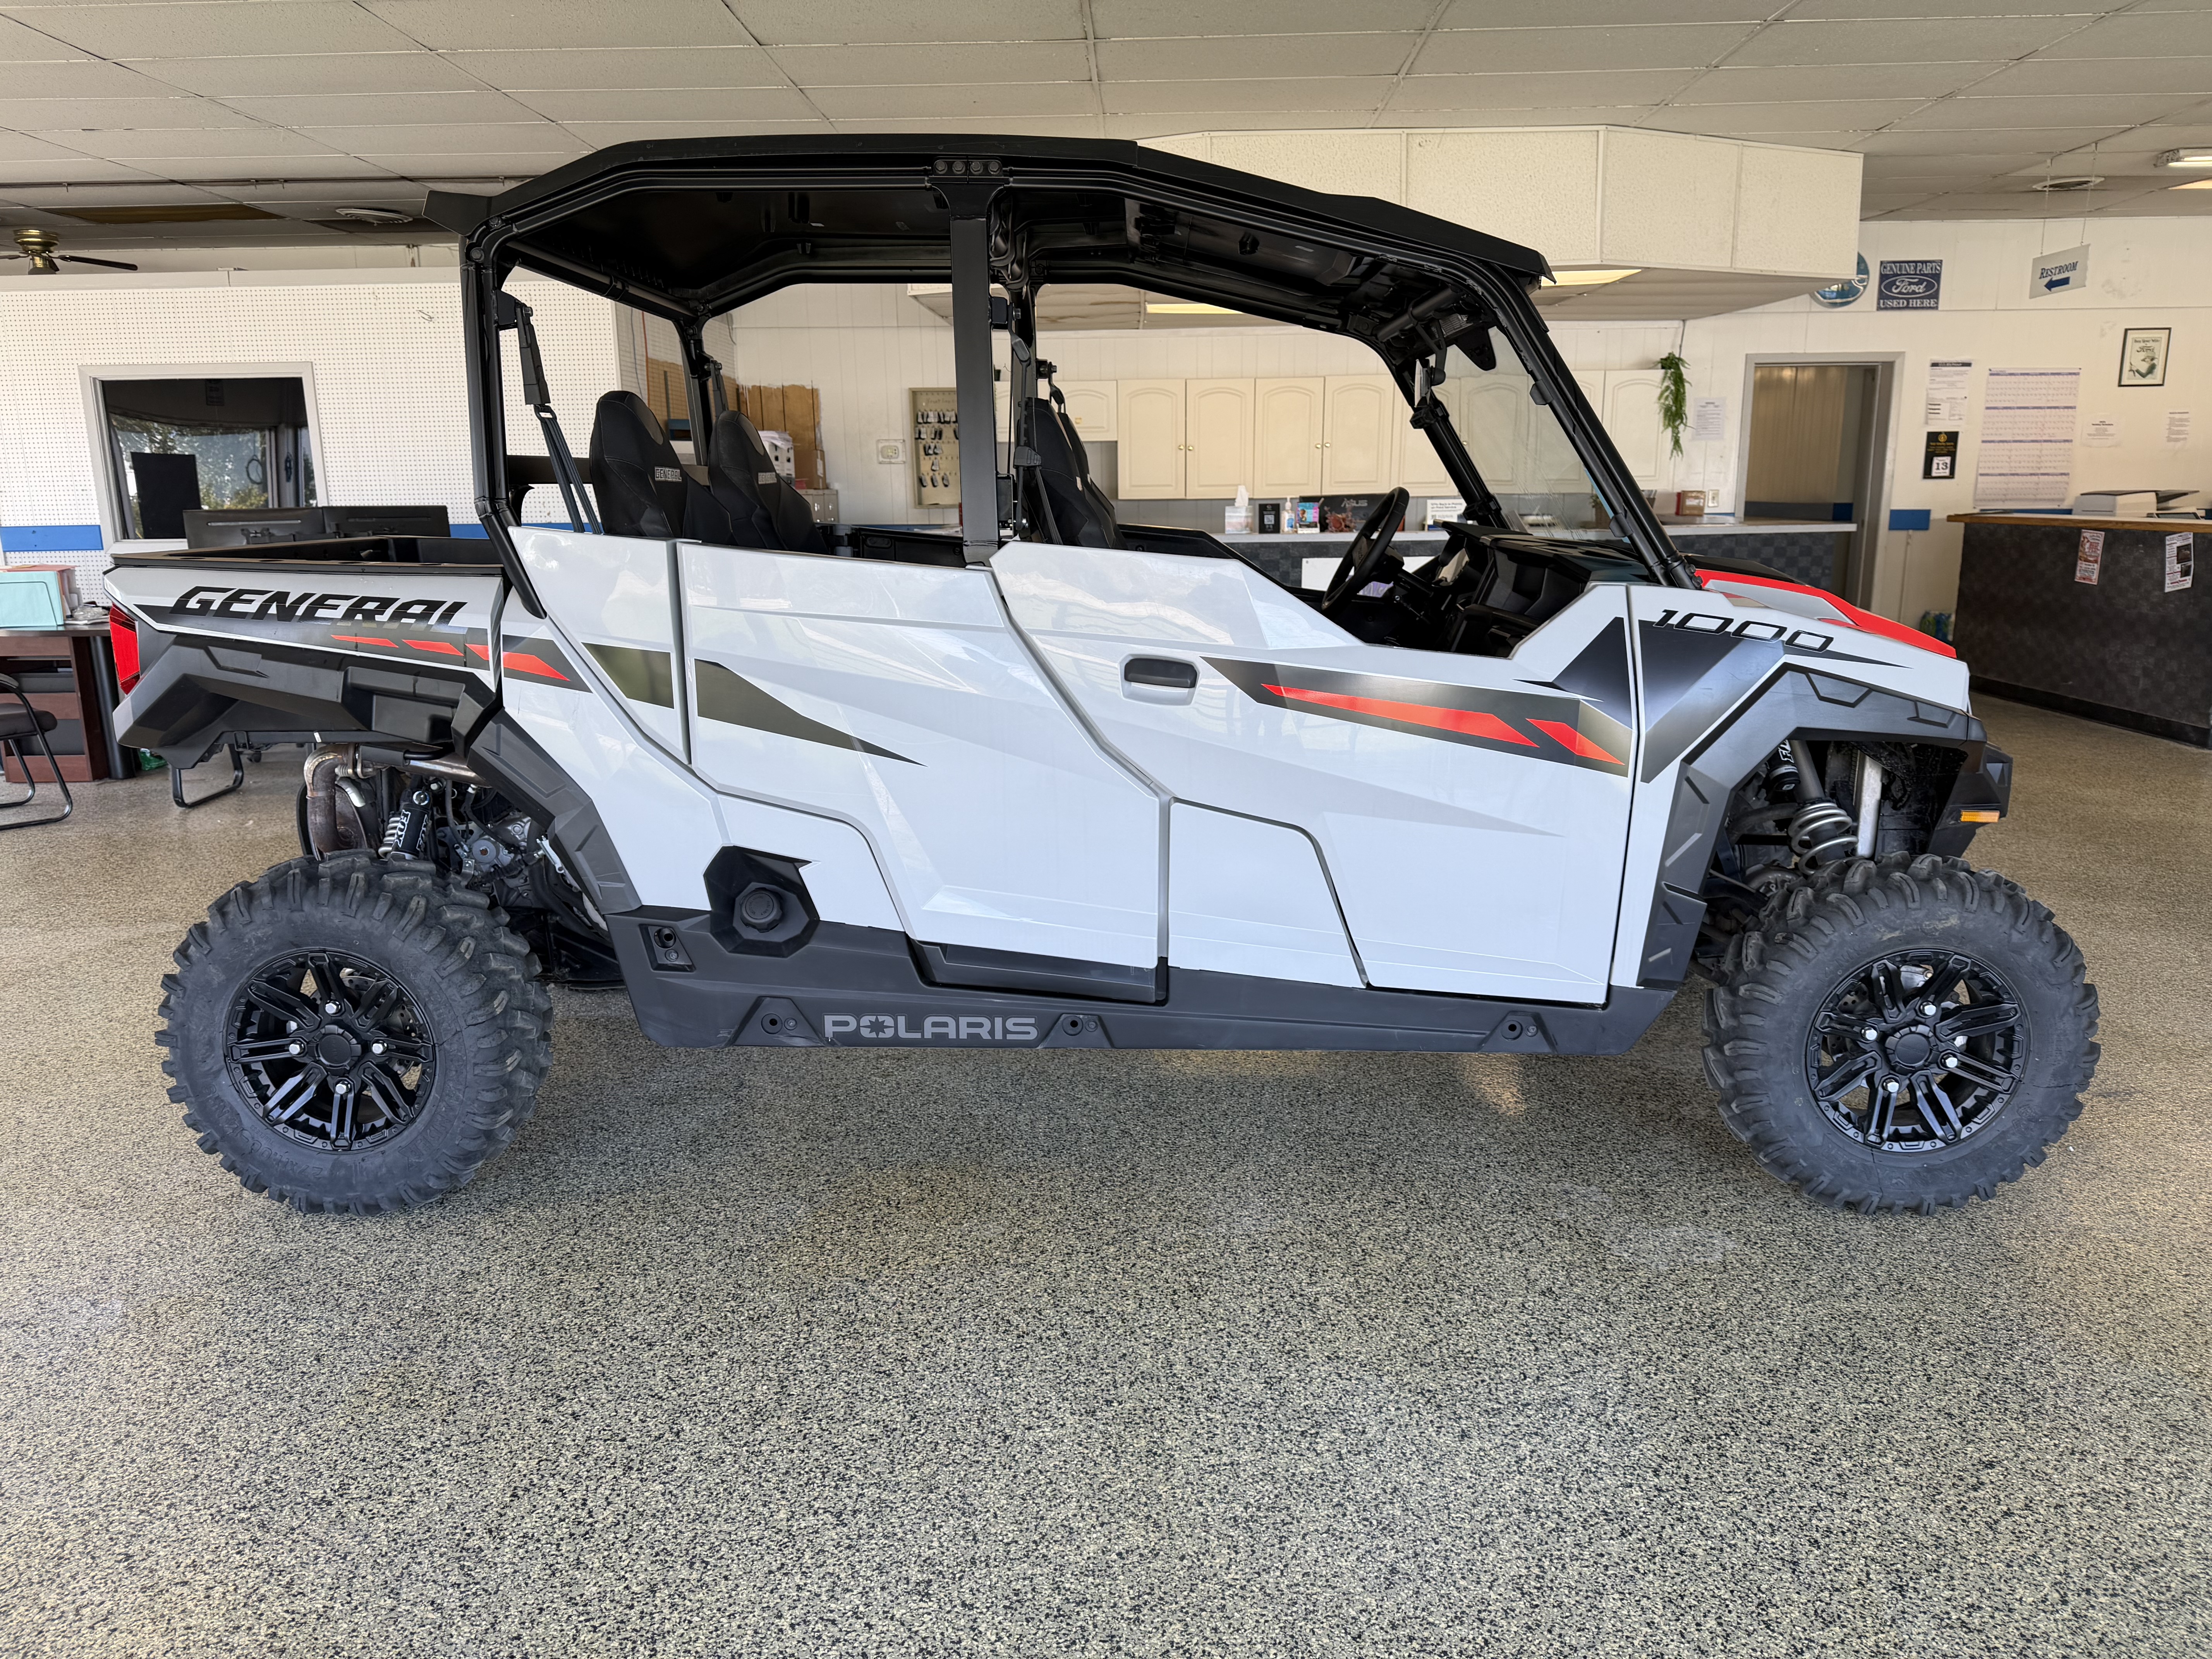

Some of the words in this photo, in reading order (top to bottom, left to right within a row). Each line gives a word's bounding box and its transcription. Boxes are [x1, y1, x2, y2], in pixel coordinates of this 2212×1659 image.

[1881, 263, 1916, 274] GENUINE
[1917, 262, 1942, 274] PARTS
[2039, 261, 2079, 279] RESTROOM
[1892, 278, 1927, 293] Ford
[1879, 299, 1906, 308] USED
[1909, 299, 1937, 307] HERE
[655, 467, 682, 481] GENERAL
[1935, 462, 1948, 471] 13
[169, 586, 468, 634] GENERAL
[1652, 609, 1834, 653] 1000
[391, 809, 411, 848] FOX
[824, 1015, 1038, 1041] POLARIS
